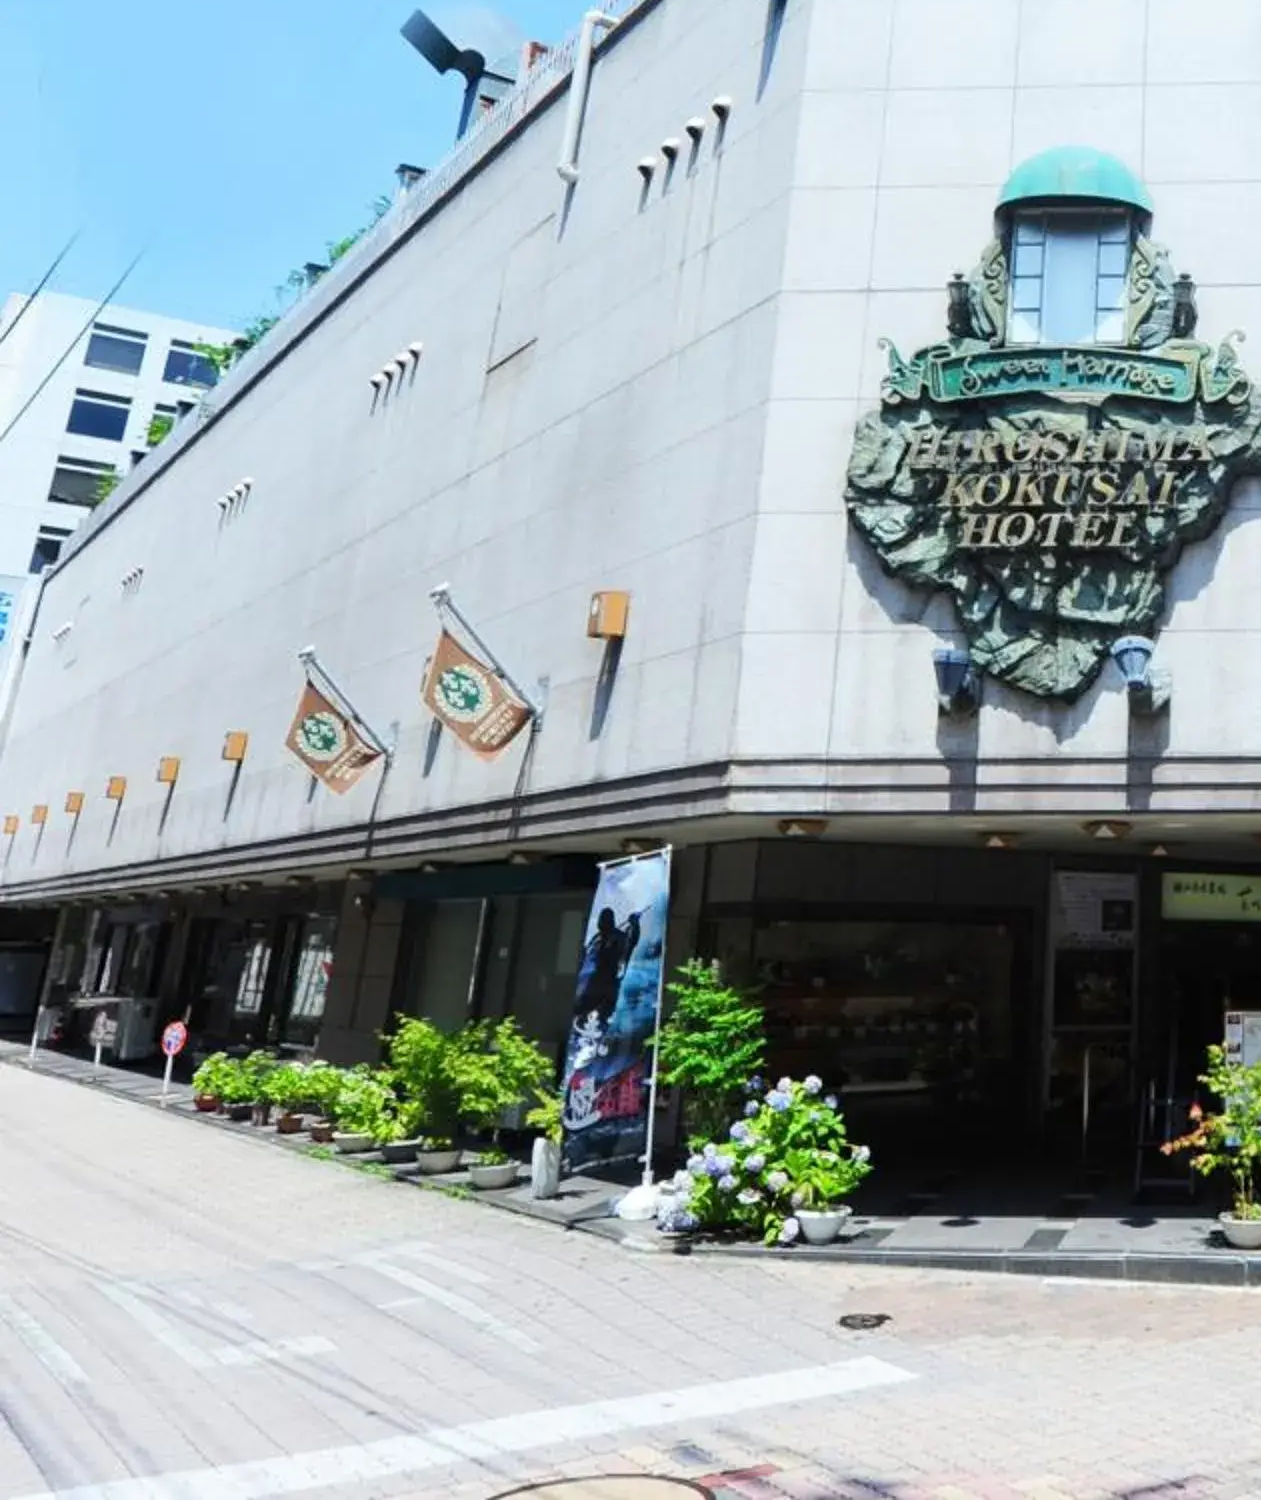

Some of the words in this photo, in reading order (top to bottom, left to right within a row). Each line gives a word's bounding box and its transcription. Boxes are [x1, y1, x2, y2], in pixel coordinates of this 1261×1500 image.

[960, 355, 1049, 396] Sweet
[1060, 350, 1175, 394] Marriage
[904, 429, 1215, 467] HIROSHIMA
[938, 470, 1179, 507] KOKUSAI
[956, 511, 1140, 548] HOTEL
